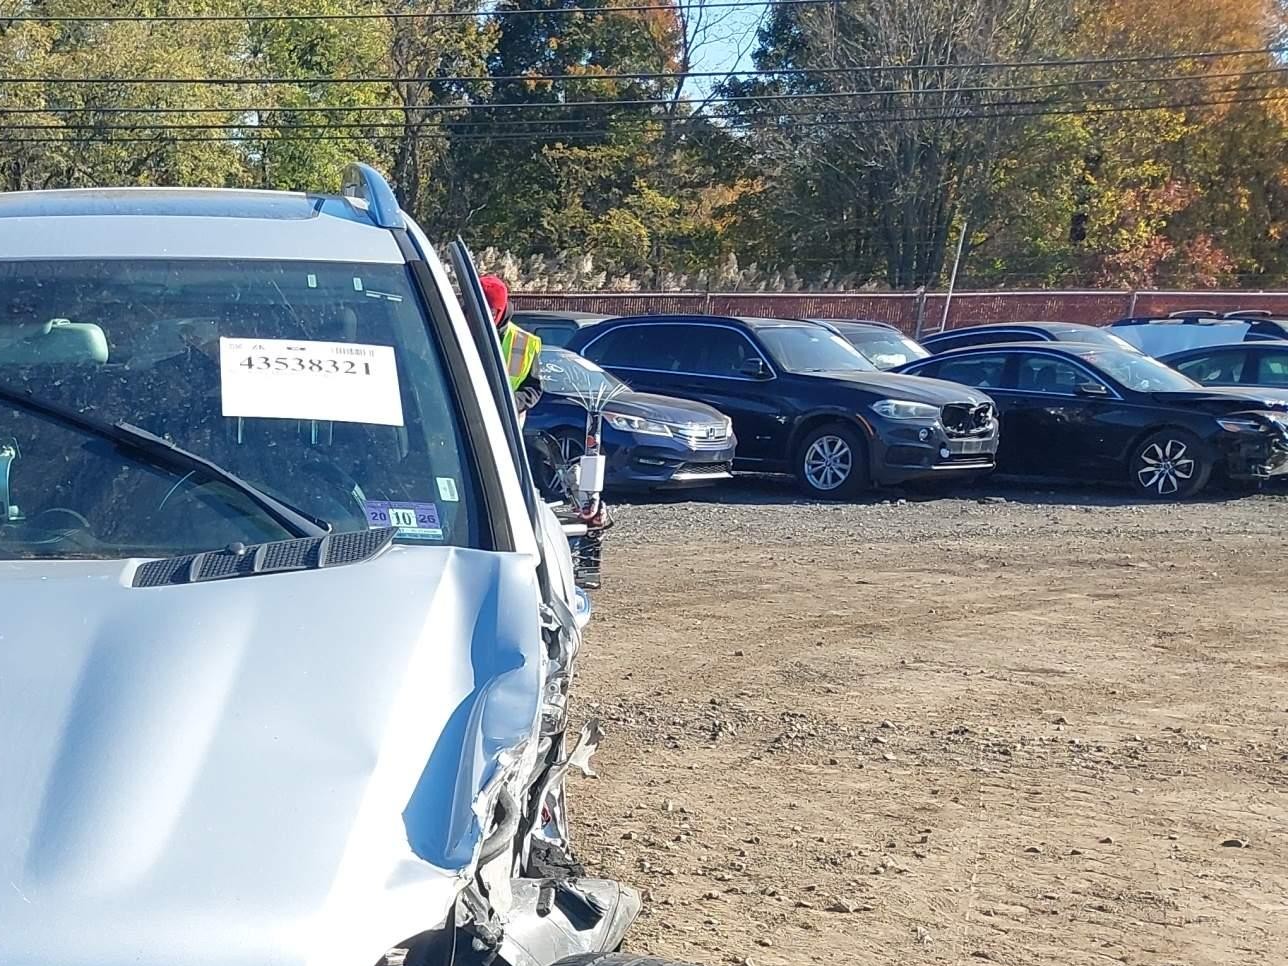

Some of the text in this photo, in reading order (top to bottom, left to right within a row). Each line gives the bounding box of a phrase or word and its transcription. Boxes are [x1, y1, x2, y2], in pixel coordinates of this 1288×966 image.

[240, 356, 371, 376] 43538321
[371, 511, 436, 526] 20 10 26
